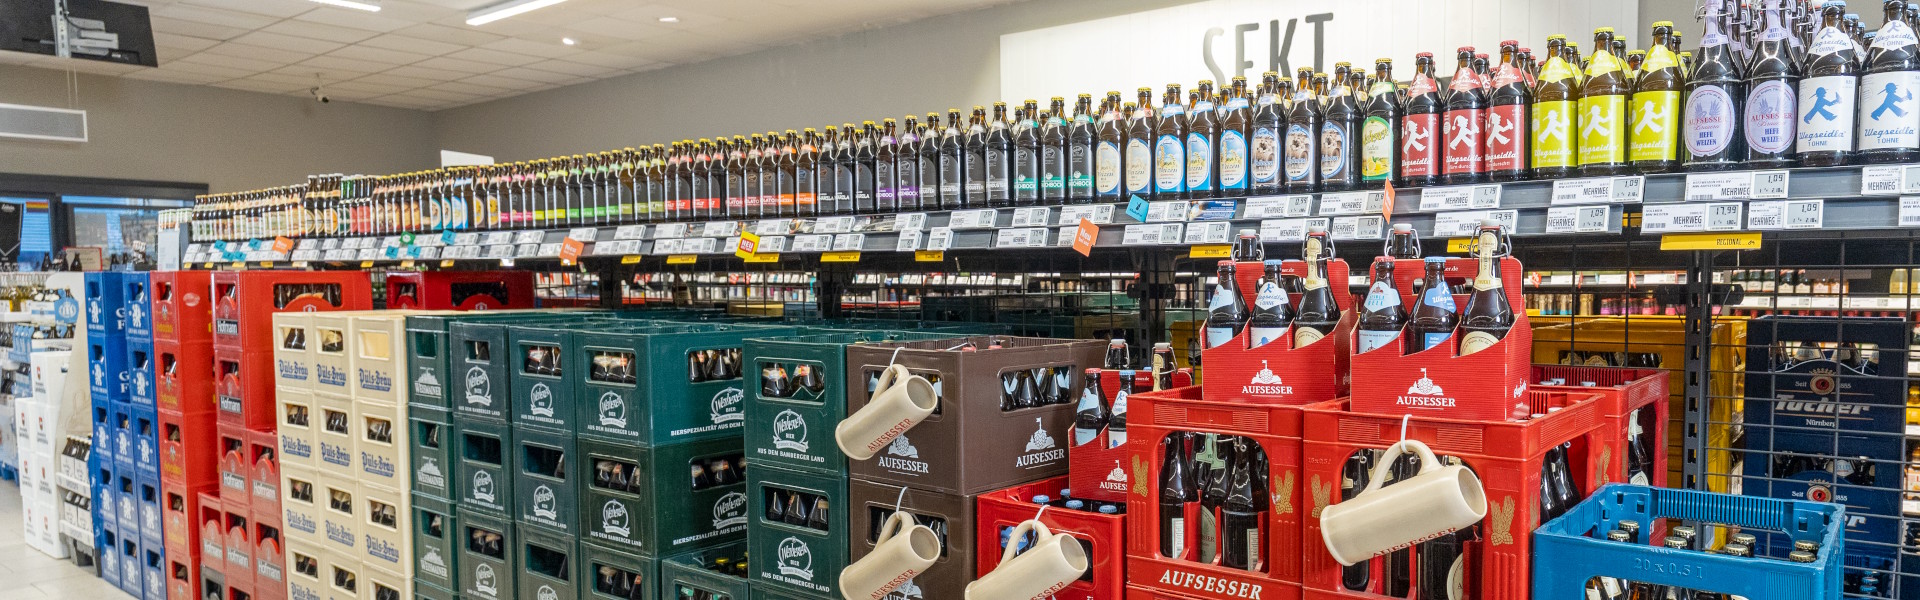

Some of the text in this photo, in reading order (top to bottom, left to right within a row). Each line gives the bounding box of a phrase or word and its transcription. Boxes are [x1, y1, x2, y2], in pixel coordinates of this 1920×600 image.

[1203, 12, 1334, 93] SEKT
[1688, 116, 1727, 126] AUFSESSE
[1799, 130, 1845, 142] Wegseidla
[1864, 127, 1915, 139] Wegseidla
[1696, 138, 1717, 146] WEIZEN
[1446, 155, 1483, 164] Wegseidla
[1868, 181, 1896, 190] MEHRWEG
[1548, 218, 1575, 227] MEHRWEG
[1672, 216, 1702, 225] MEHRWEG
[1750, 216, 1776, 226] MEHRWEG
[1716, 238, 1742, 246] REGIONAL
[216, 320, 238, 334] Hofmann
[1242, 386, 1293, 394] AUFSESSER
[220, 398, 241, 413] Hofmann
[1396, 396, 1456, 407] AUFSESSER
[1775, 394, 1871, 415] Tucher
[670, 424, 717, 436] BIERSPEZIALITÄT
[866, 418, 914, 452] AUFSESSER
[768, 449, 778, 457] DEM
[780, 450, 810, 461] BAMBERGER
[811, 455, 824, 463] LAND
[1015, 448, 1065, 468] AUFSESSER
[878, 456, 928, 474] AUFSESSER
[223, 473, 245, 491] Hofmann
[631, 538, 642, 547] LAND
[672, 532, 719, 546] BIERSPEZIALITÄT
[227, 550, 248, 568] Hofmann
[1634, 556, 1650, 571] 20
[1654, 564, 1664, 573] x
[1668, 563, 1691, 576] 0,5
[258, 562, 282, 582] Hofmann
[772, 573, 784, 582] DEM
[784, 576, 814, 590] BAMBERGER
[816, 584, 830, 593] LAND
[870, 568, 918, 600] AUFSESSER
[1160, 569, 1263, 600] AUFSESSER
